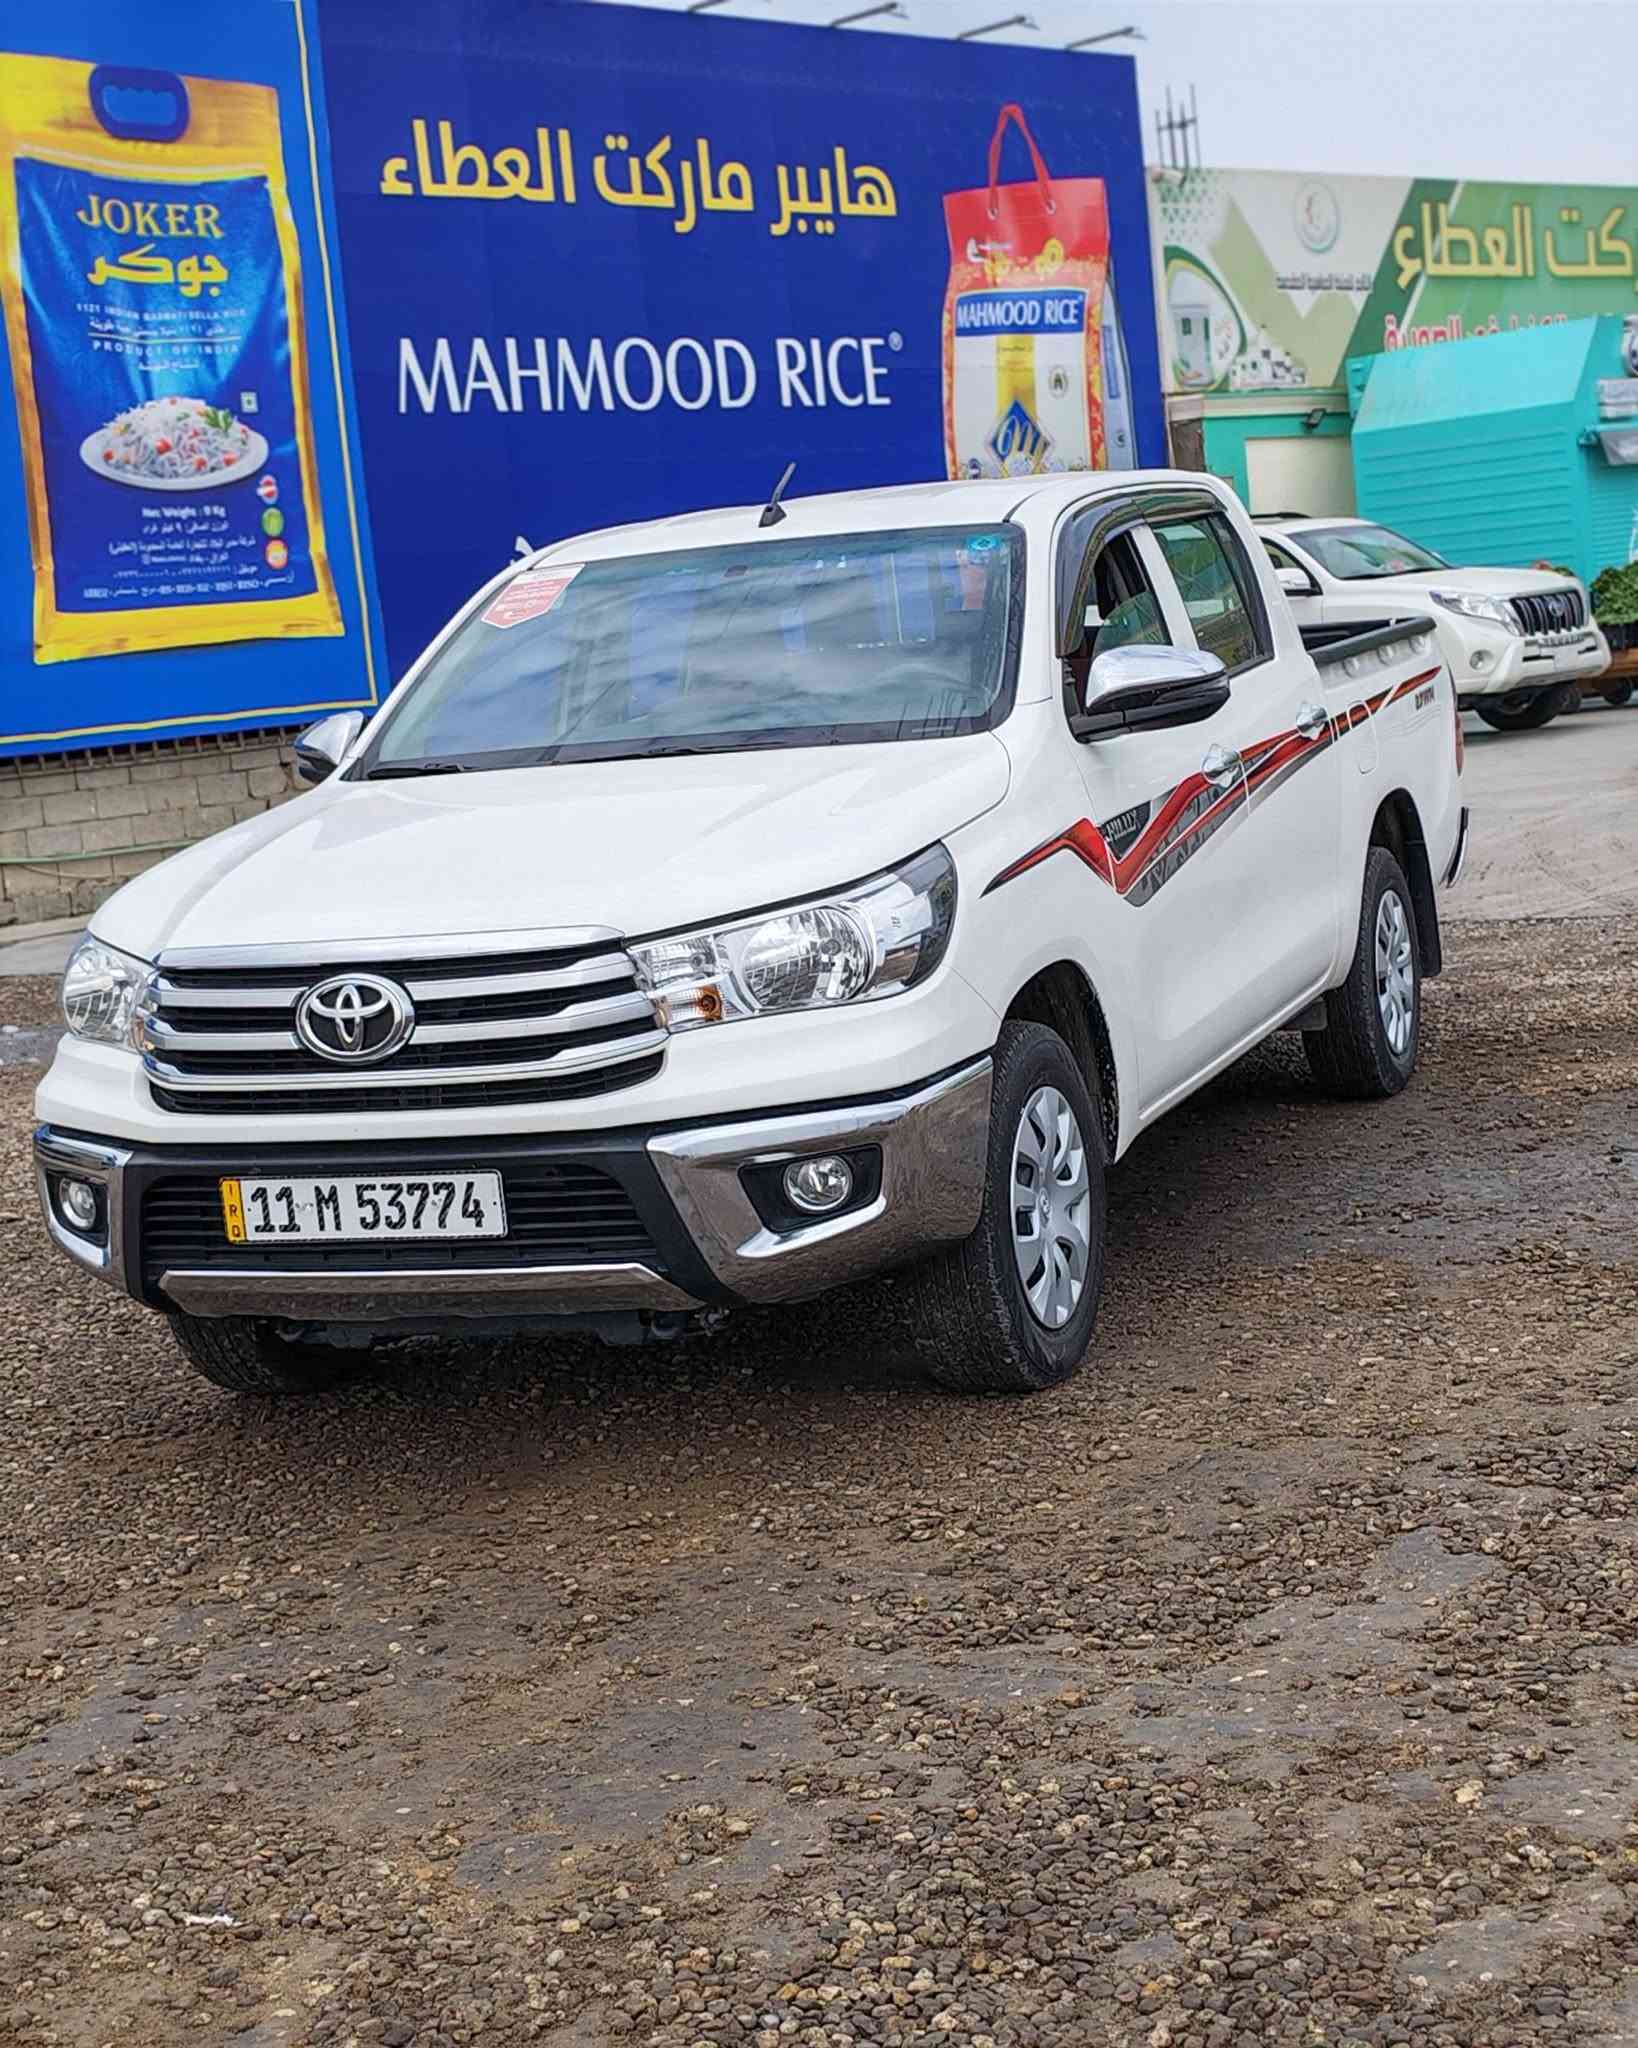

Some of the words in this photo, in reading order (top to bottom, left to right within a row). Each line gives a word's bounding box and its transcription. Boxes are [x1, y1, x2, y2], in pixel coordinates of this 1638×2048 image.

[380, 118, 577, 204] العطاء
[592, 135, 755, 234] ماركت
[770, 147, 898, 236] هايبر
[76, 194, 225, 239] JOKER
[1393, 202, 1536, 290] العطاء
[87, 242, 229, 298] جوكر
[957, 298, 1041, 330] MAHMOOD
[398, 337, 757, 416] MAHMOOD
[250, 1185, 301, 1233] 11
[314, 1184, 342, 1232] M
[355, 1180, 486, 1231] 53774
